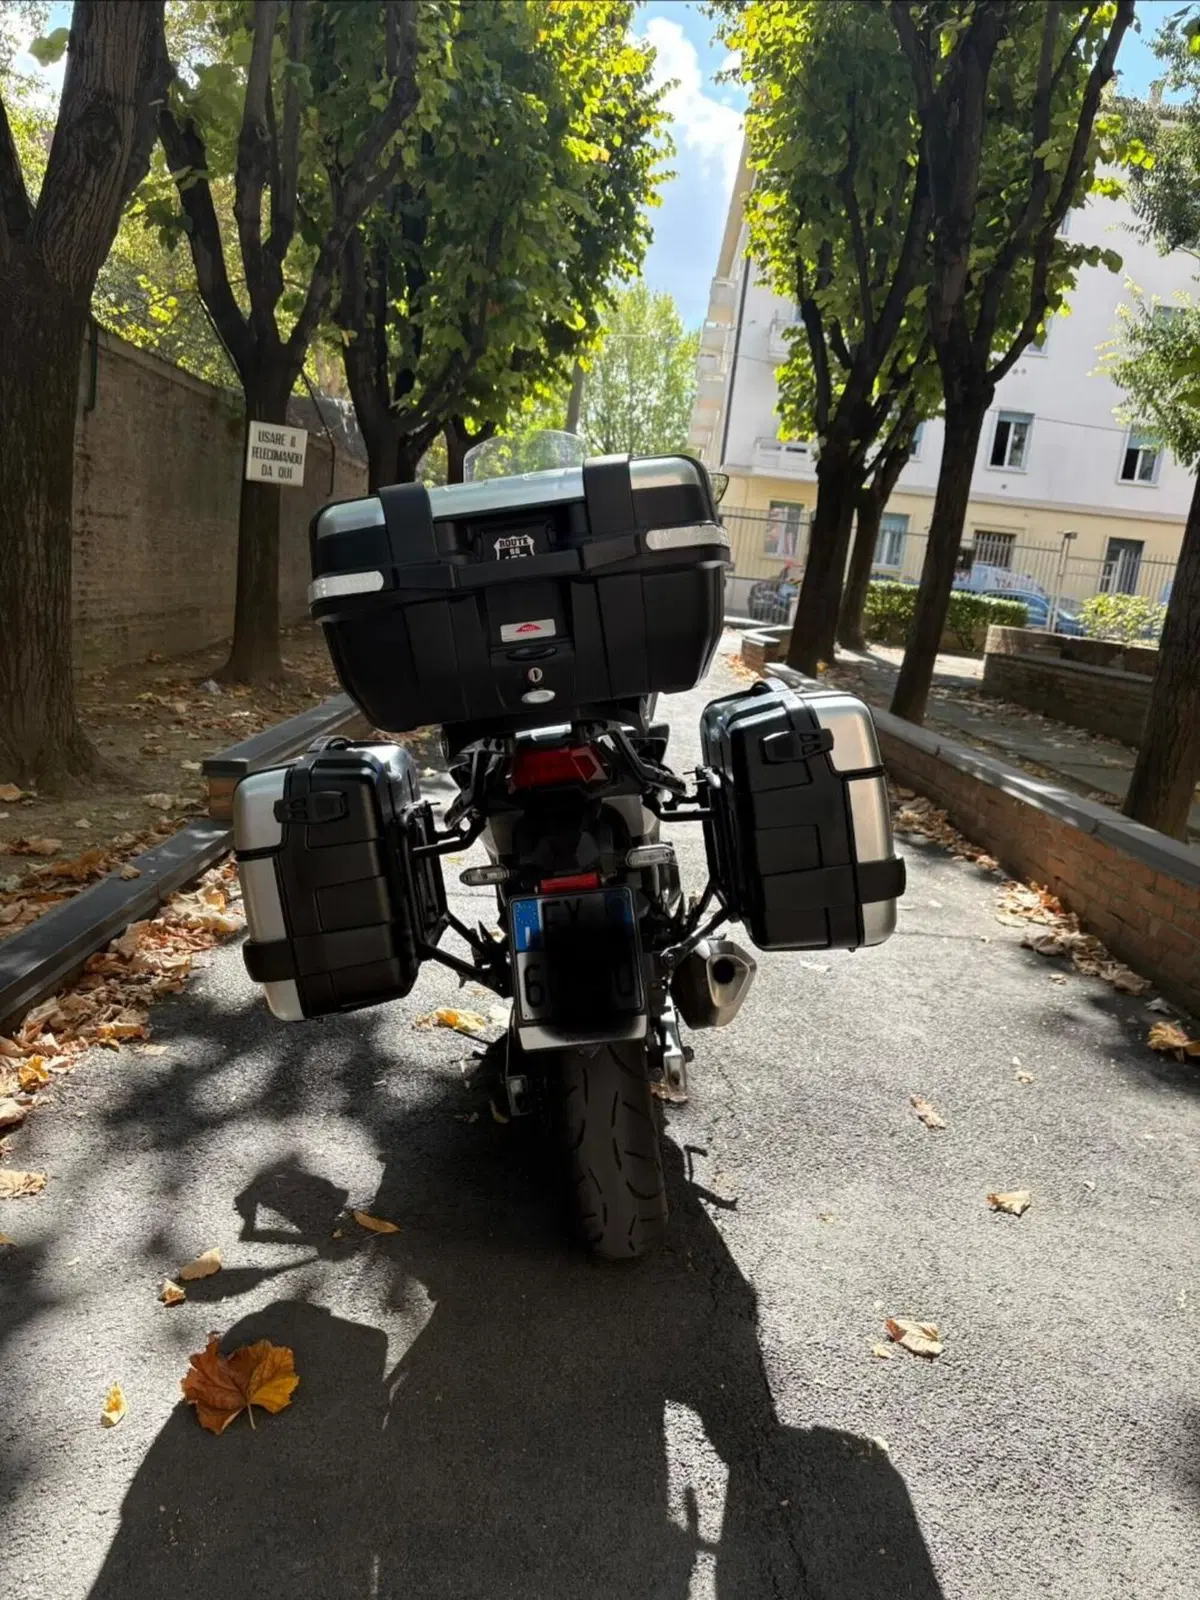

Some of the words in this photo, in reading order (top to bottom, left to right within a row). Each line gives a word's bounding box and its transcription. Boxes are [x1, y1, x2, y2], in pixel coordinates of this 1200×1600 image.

[258, 430, 286, 446] USARE
[261, 463, 273, 476] DA
[278, 466, 293, 480] QUI
[499, 537, 529, 548] ROUTE
